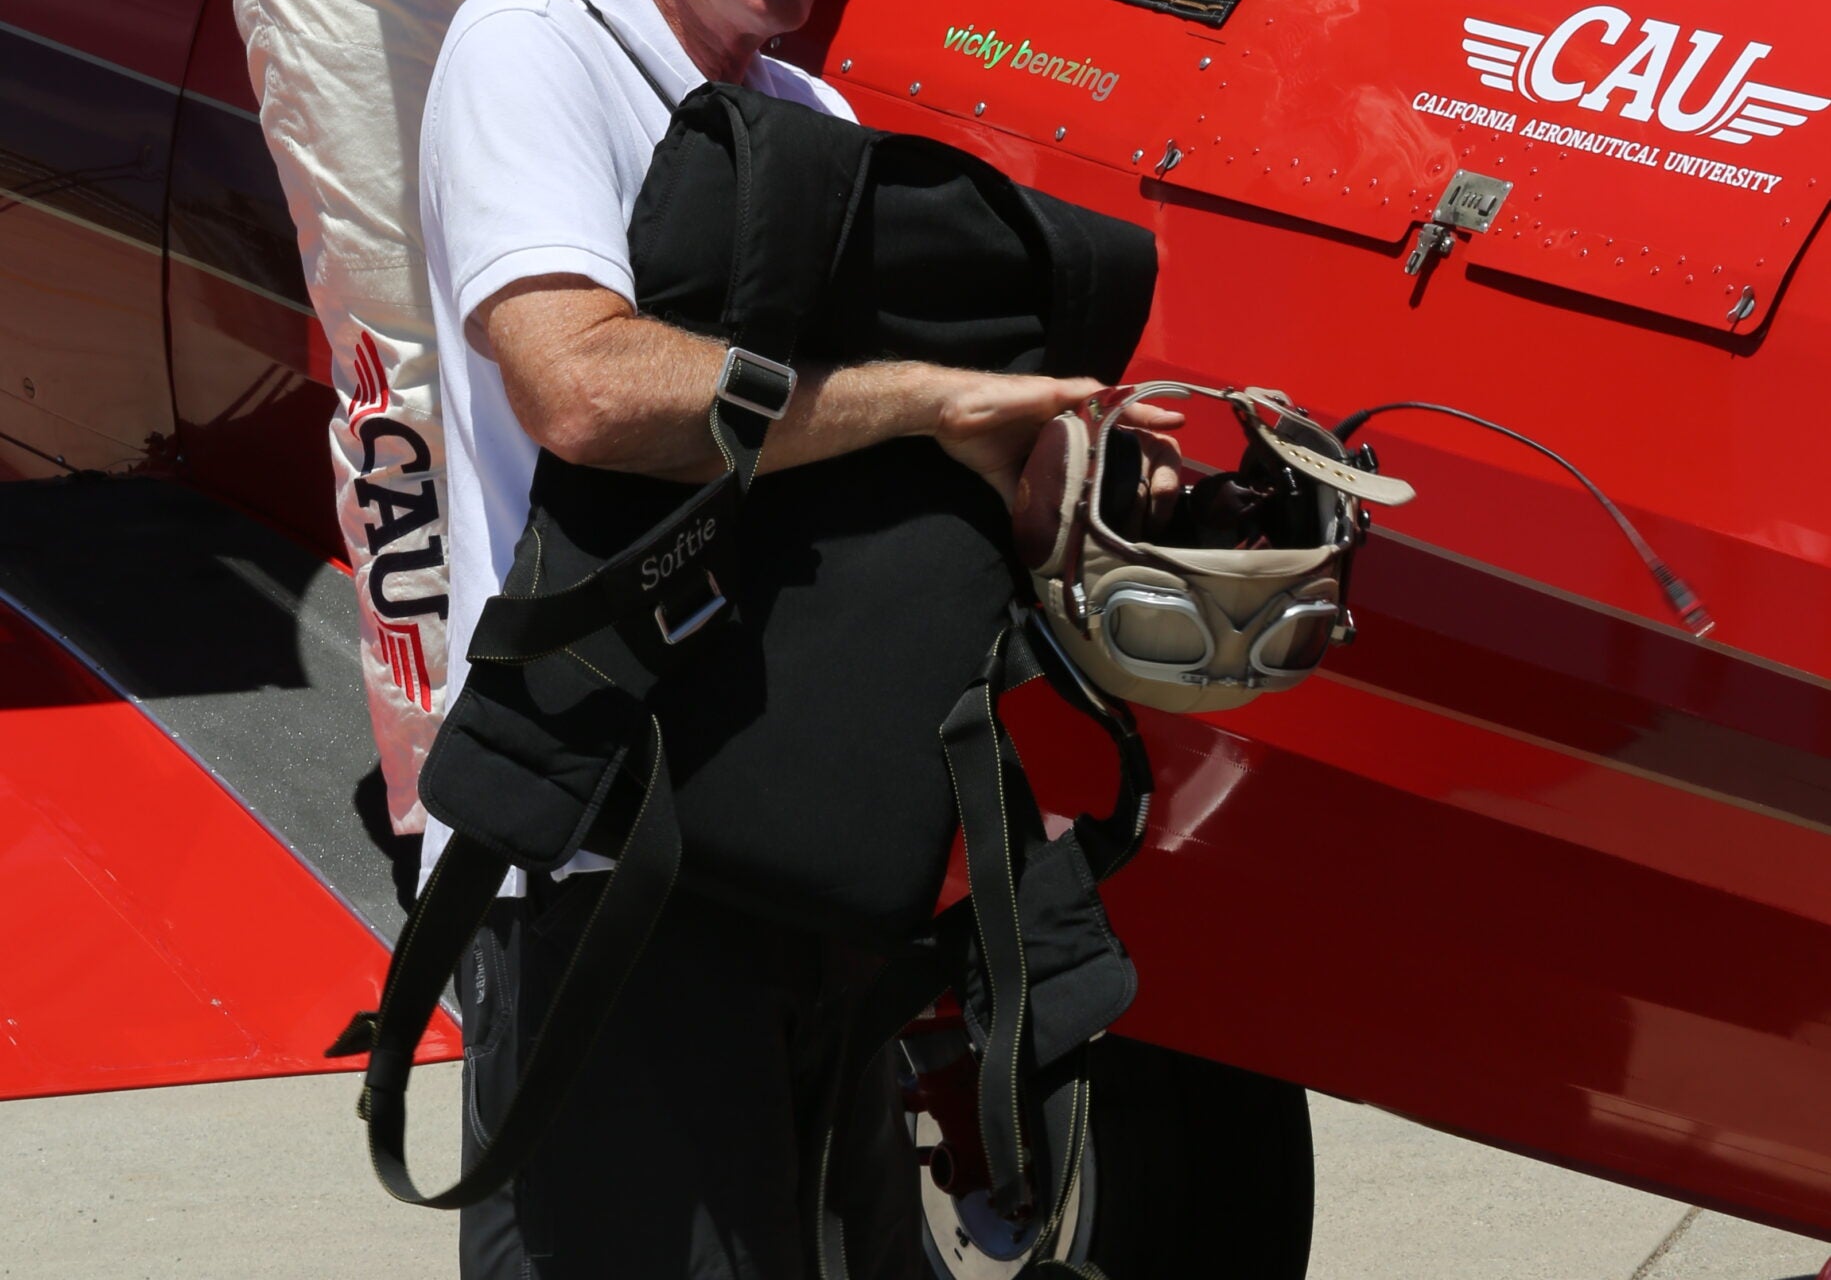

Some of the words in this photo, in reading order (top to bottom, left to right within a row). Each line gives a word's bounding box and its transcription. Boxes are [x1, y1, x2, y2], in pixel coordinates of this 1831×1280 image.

[943, 24, 1013, 69] vicky
[1009, 39, 1120, 102] benzing
[1530, 5, 1773, 134] CAU
[1411, 91, 1518, 133] CALIFORNIA
[1519, 118, 1659, 168] AERONAUTICAL
[1663, 151, 1783, 195] UNIVERSITY
[353, 417, 450, 621] CAU
[641, 518, 717, 592] Softie
